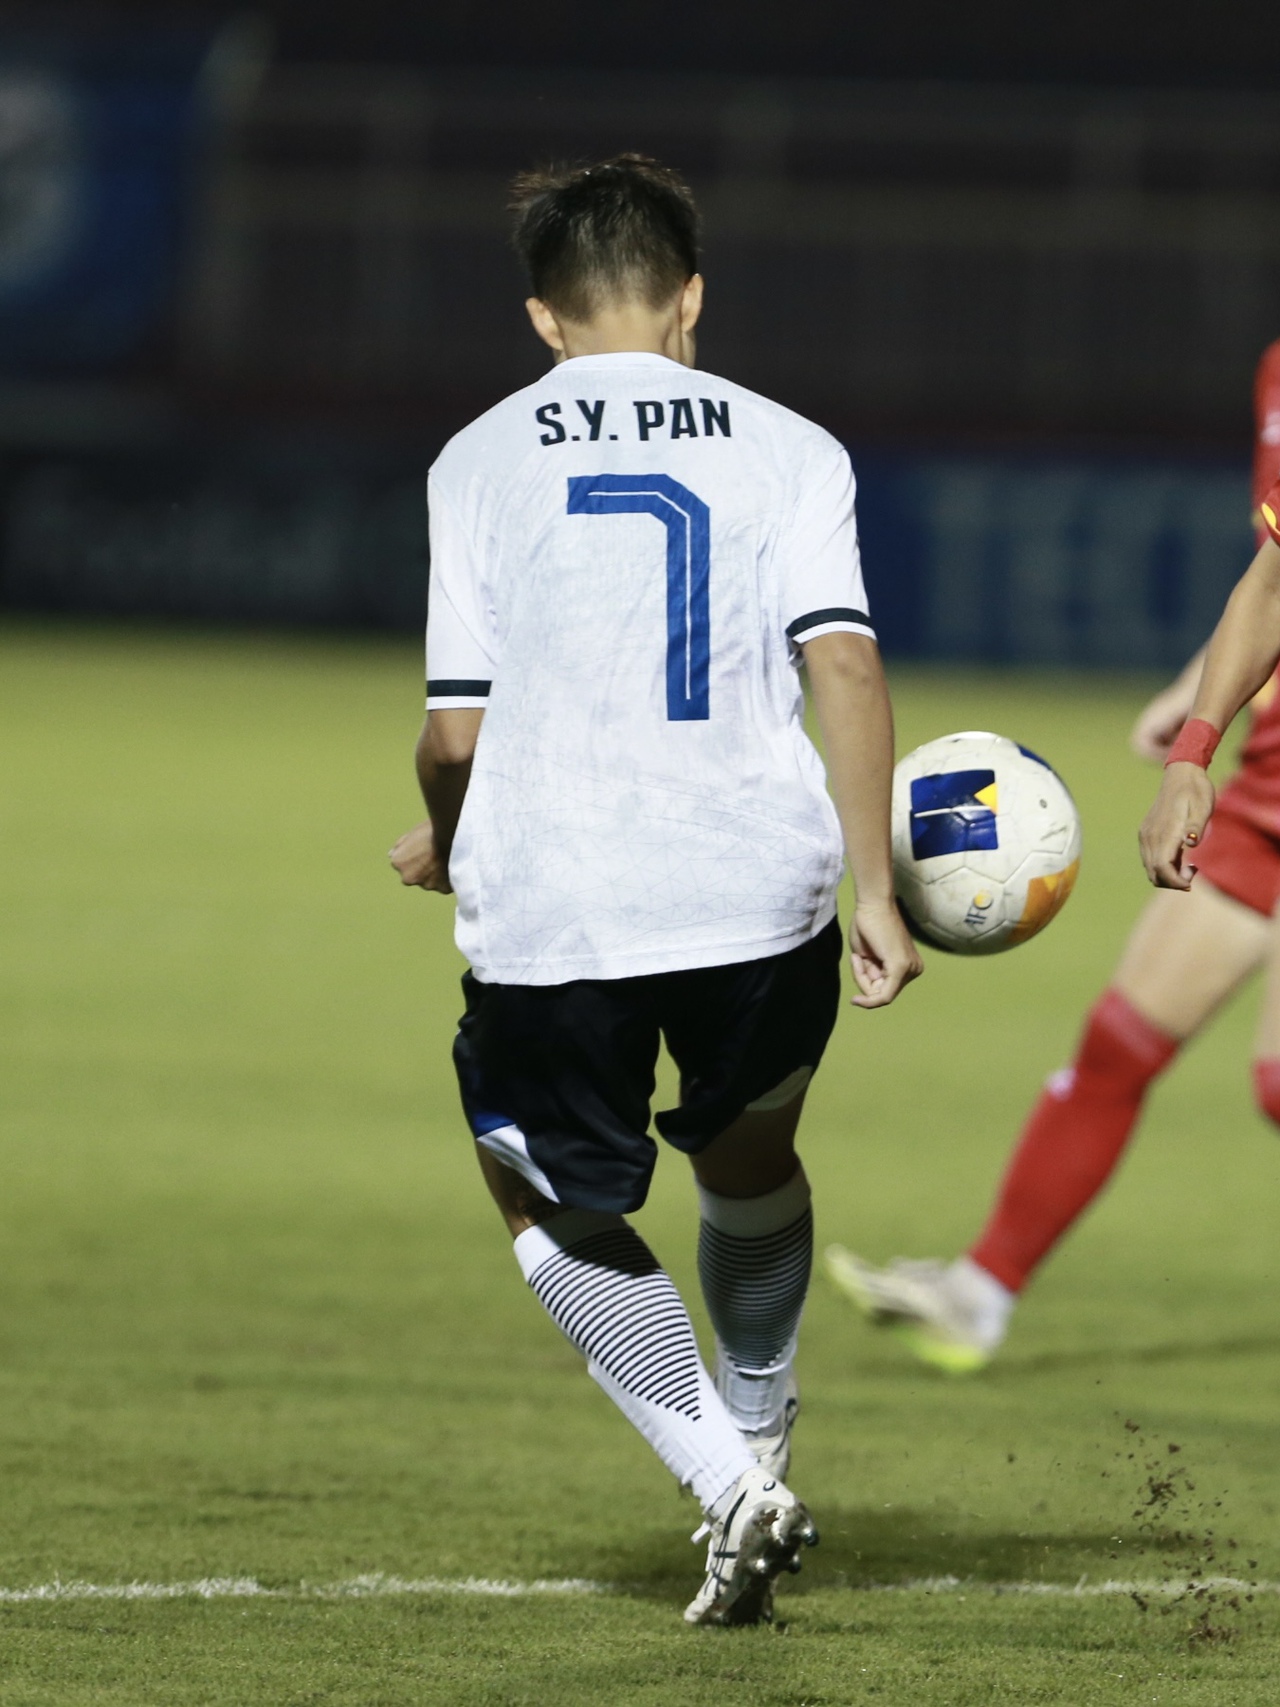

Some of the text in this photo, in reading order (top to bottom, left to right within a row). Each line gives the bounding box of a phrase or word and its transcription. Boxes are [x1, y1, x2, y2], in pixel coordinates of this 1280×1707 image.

[534, 398, 732, 446] S.Y. PAN
[566, 473, 711, 721] 7
